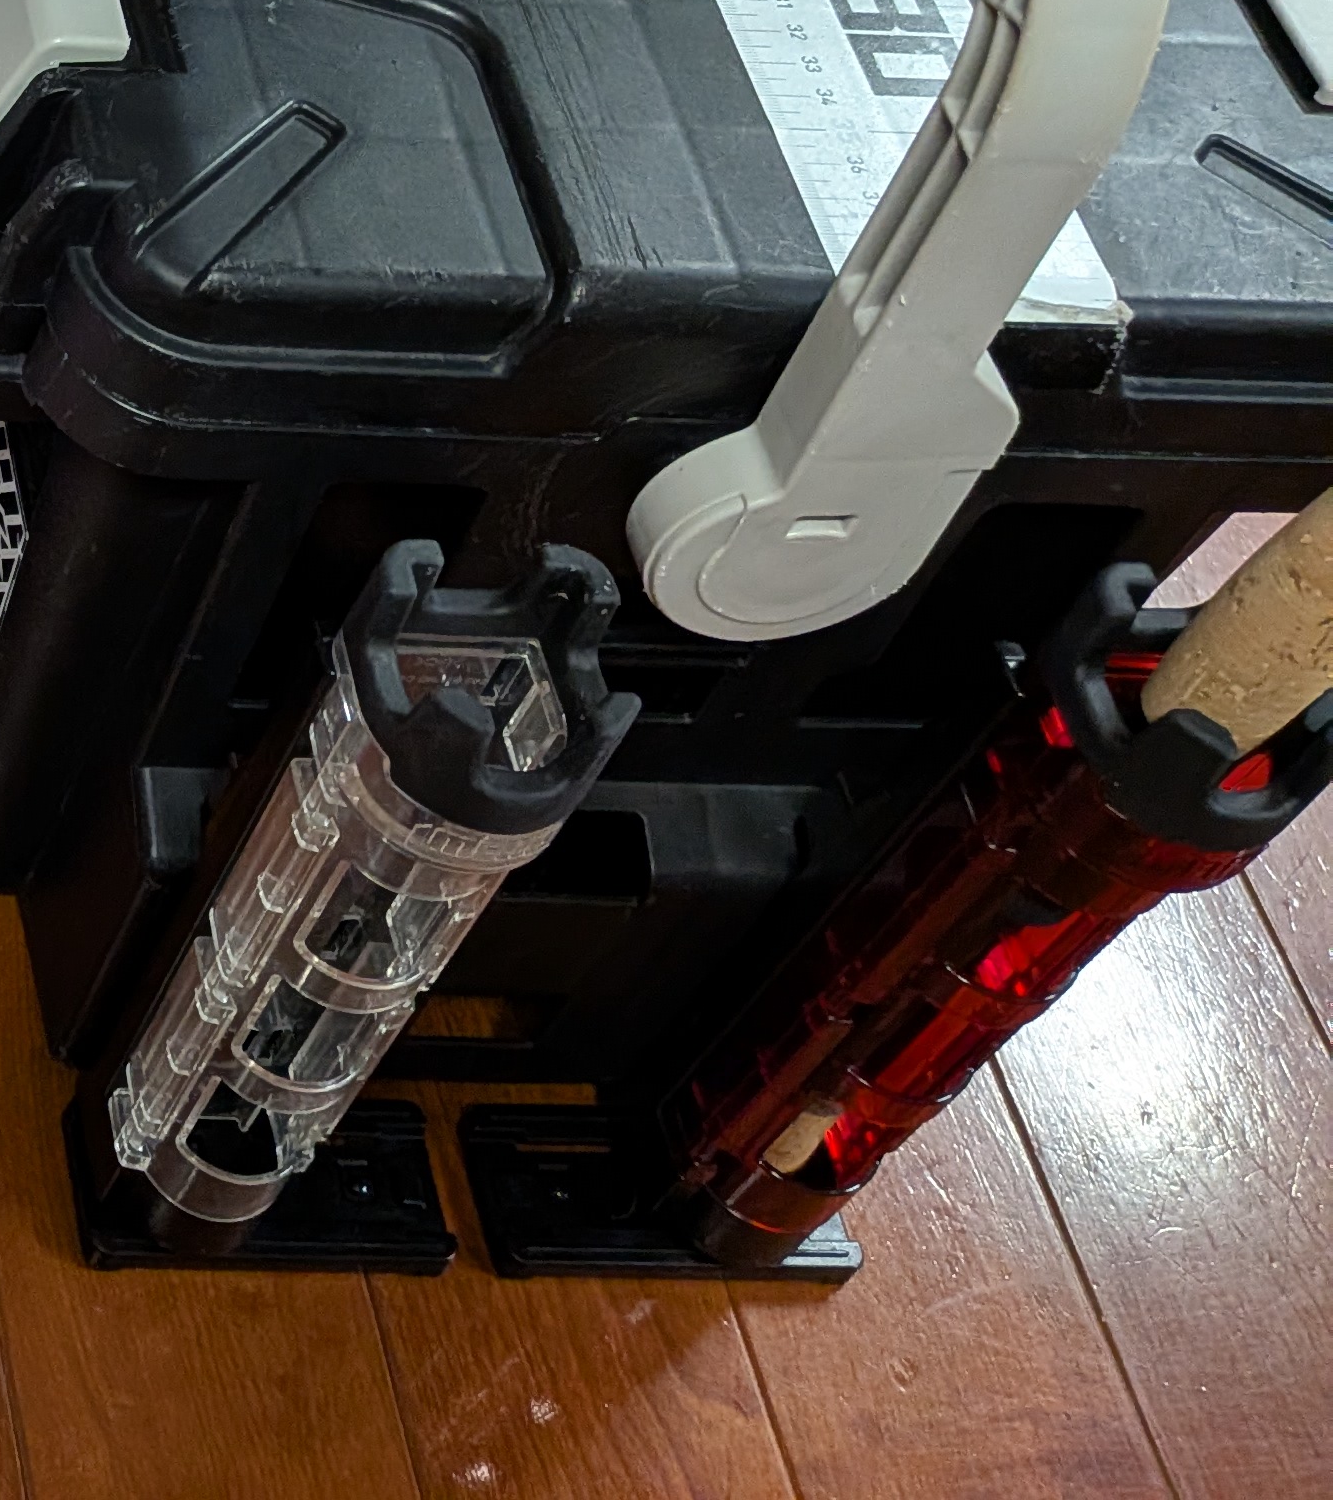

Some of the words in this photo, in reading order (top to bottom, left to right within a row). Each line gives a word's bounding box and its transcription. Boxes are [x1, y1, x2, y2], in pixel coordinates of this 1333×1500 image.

[786, 23, 808, 42] 32
[800, 55, 823, 73] 33
[815, 87, 838, 106] 34
[845, 156, 871, 176] 36
